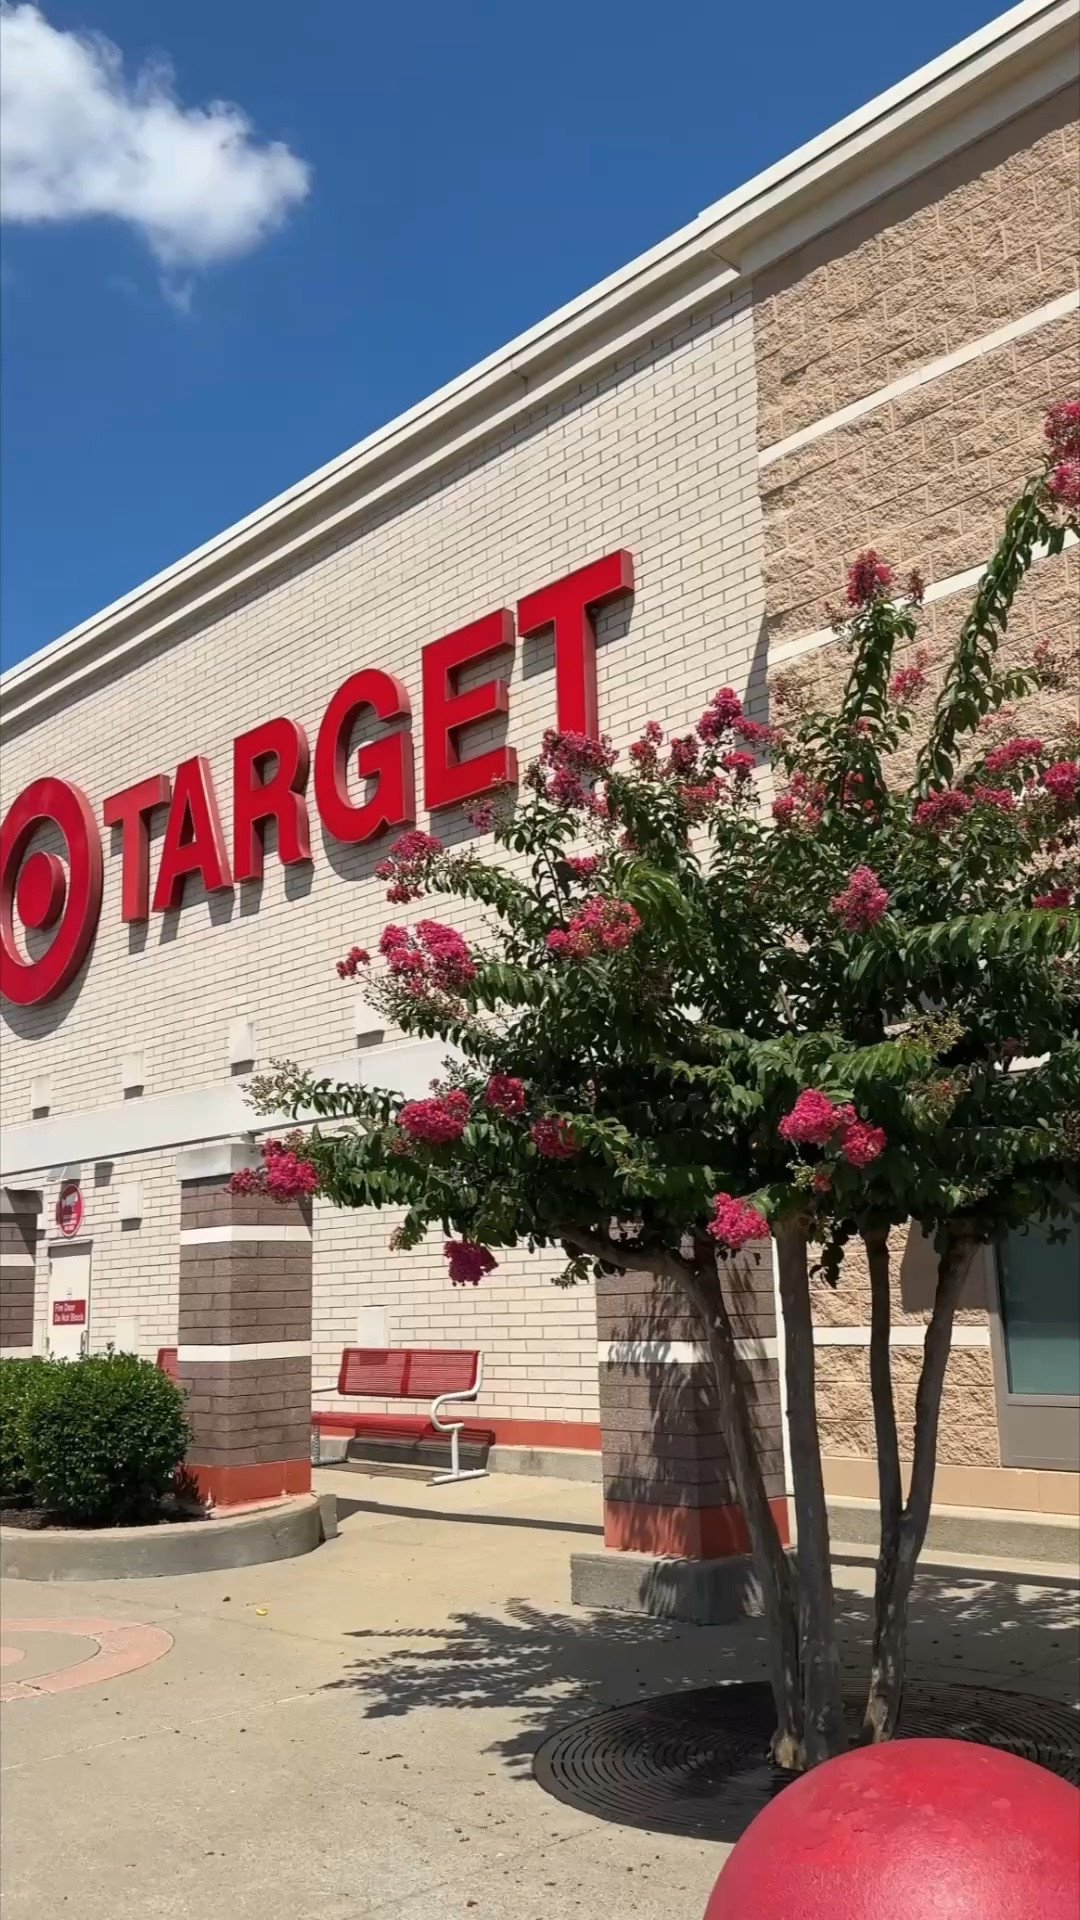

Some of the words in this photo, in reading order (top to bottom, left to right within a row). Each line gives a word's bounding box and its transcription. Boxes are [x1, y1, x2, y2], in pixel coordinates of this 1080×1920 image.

[104, 549, 634, 923] TARGET
[64, 1303, 75, 1311] Door
[54, 1313, 61, 1322] Do
[61, 1313, 69, 1321] Not
[70, 1312, 84, 1322] Block
